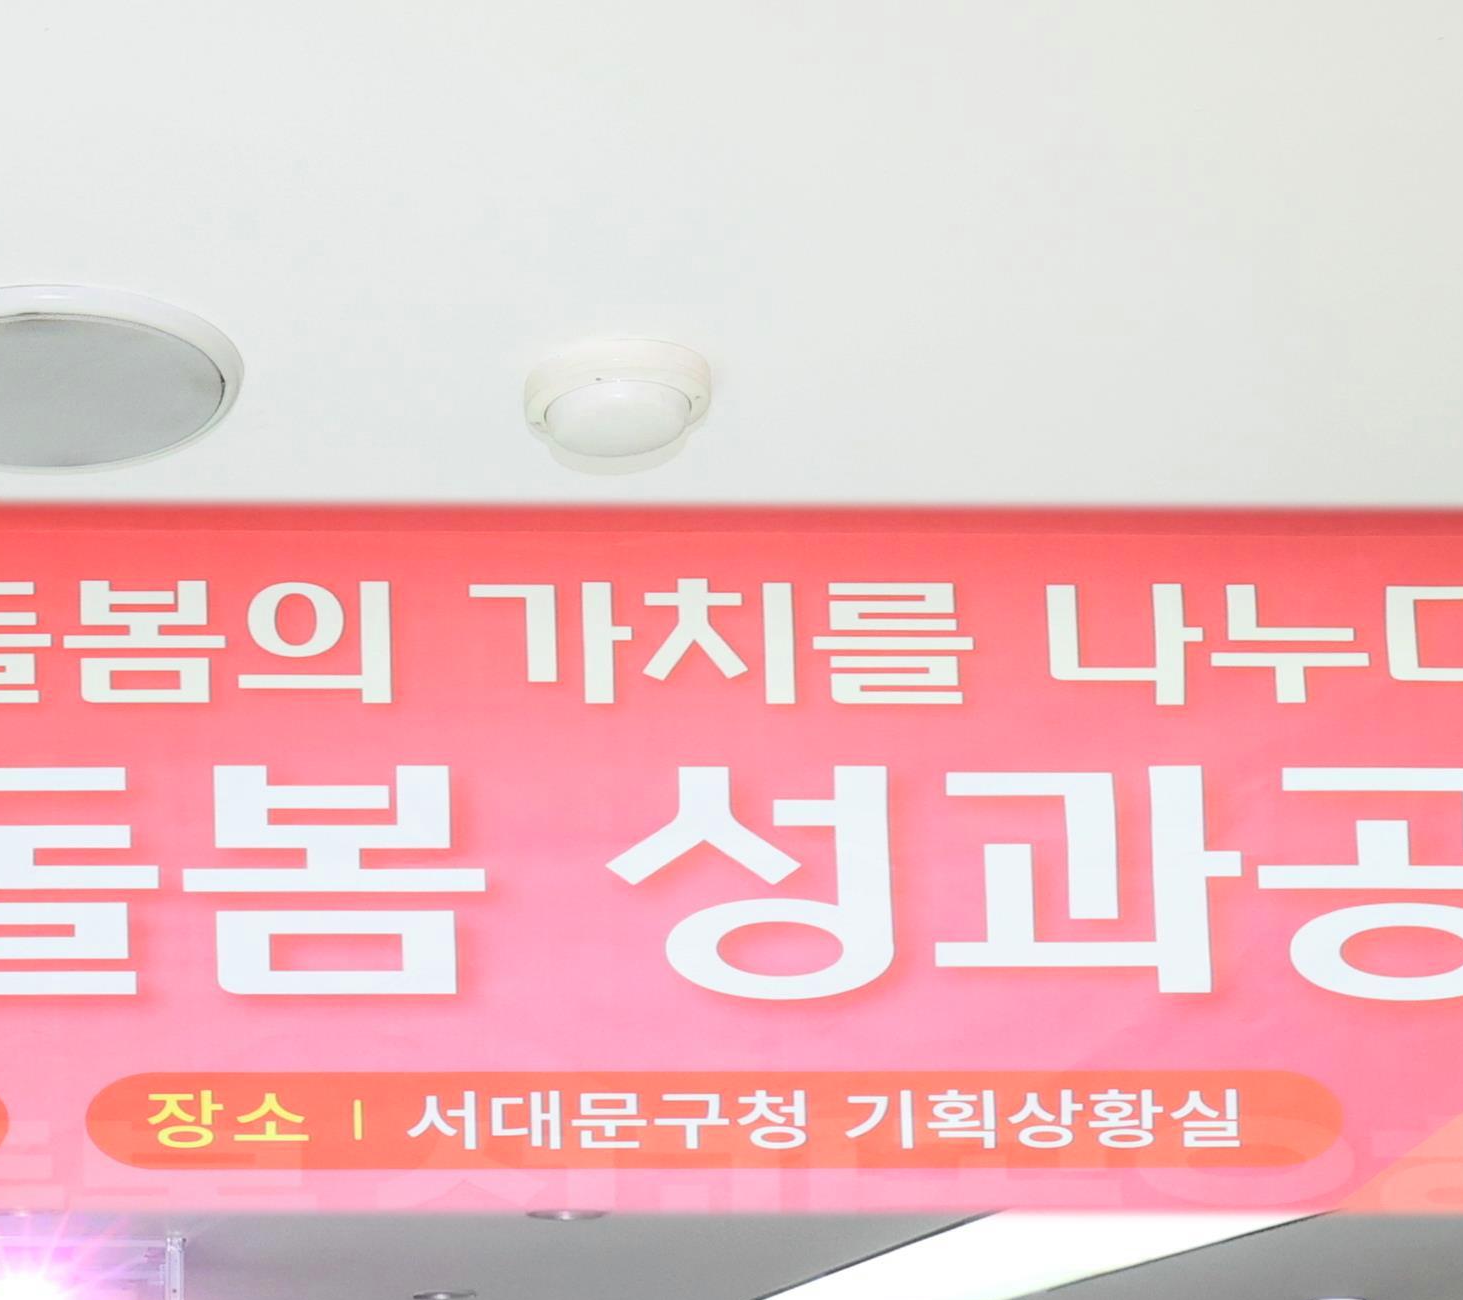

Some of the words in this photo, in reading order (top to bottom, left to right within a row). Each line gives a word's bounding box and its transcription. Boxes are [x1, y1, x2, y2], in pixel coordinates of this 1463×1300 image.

[469, 578, 974, 705] 가치를
[148, 1089, 309, 1149] 장소
[407, 1089, 808, 1150] 서대문구청
[845, 1088, 1241, 1150] 기획상황실
